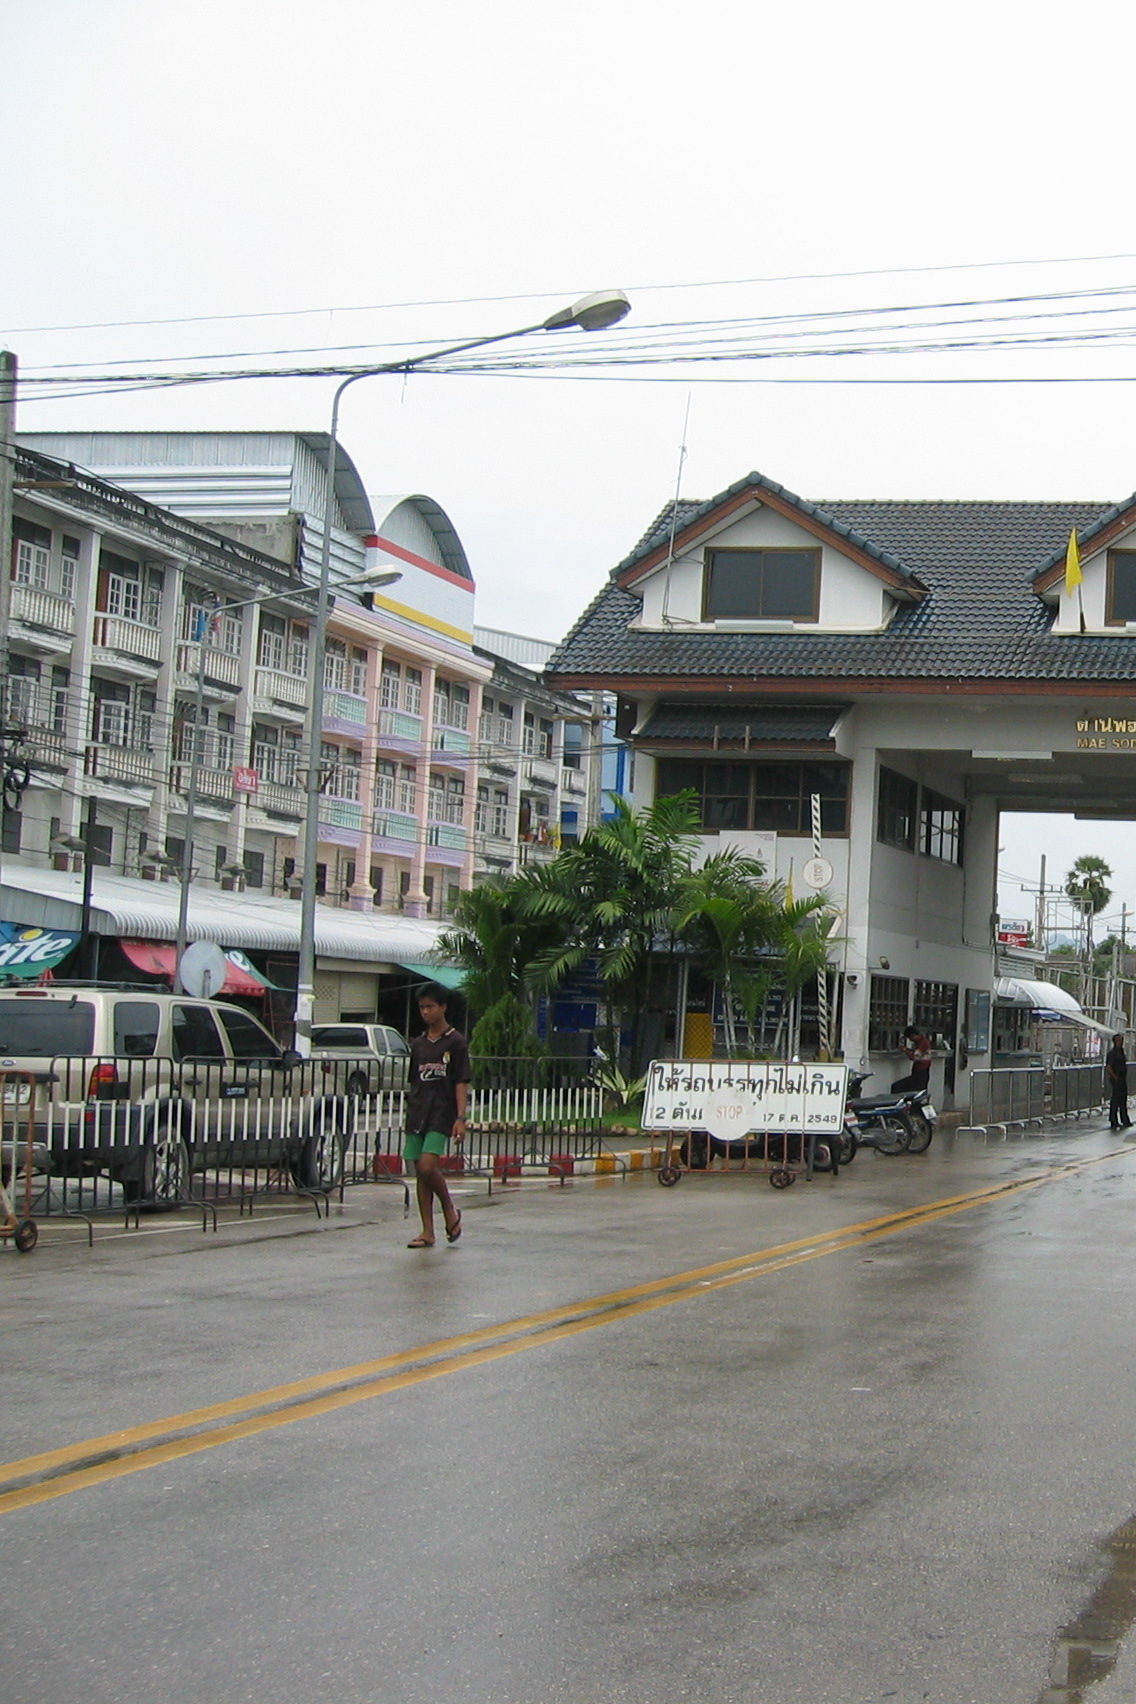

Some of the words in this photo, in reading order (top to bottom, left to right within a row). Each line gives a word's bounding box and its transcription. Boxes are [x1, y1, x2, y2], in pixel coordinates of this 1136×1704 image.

[1076, 738, 1107, 749] MAE
[0, 928, 72, 966] ite
[715, 1105, 743, 1119] STOP
[763, 1113, 775, 1123] 17
